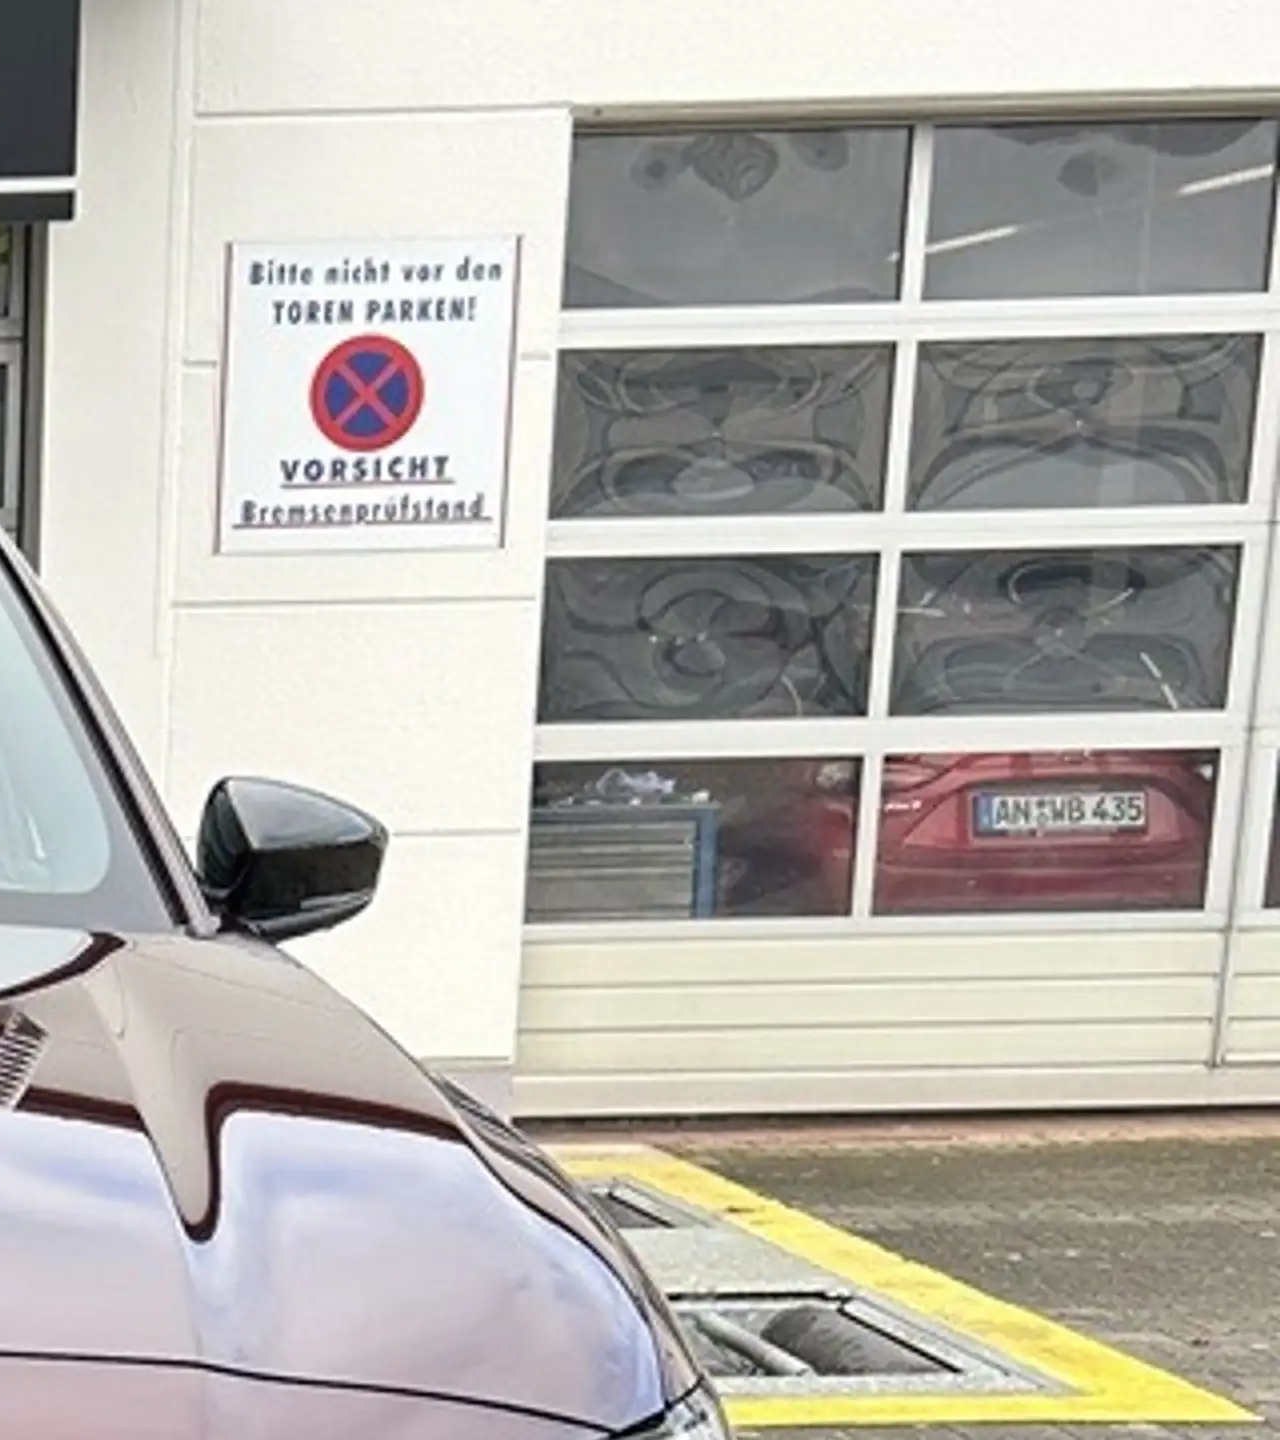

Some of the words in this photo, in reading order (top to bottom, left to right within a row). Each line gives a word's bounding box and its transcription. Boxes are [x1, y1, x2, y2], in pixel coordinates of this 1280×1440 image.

[248, 260, 314, 286] Bitte
[324, 256, 391, 285] nicht
[401, 263, 445, 283] vor
[455, 255, 503, 282] den
[272, 299, 354, 325] TOREN
[365, 296, 478, 323] PARKEN!
[280, 455, 450, 482] VORSICHT
[241, 492, 486, 527] Bremsenprüfstand
[1091, 795, 1144, 822] 435
